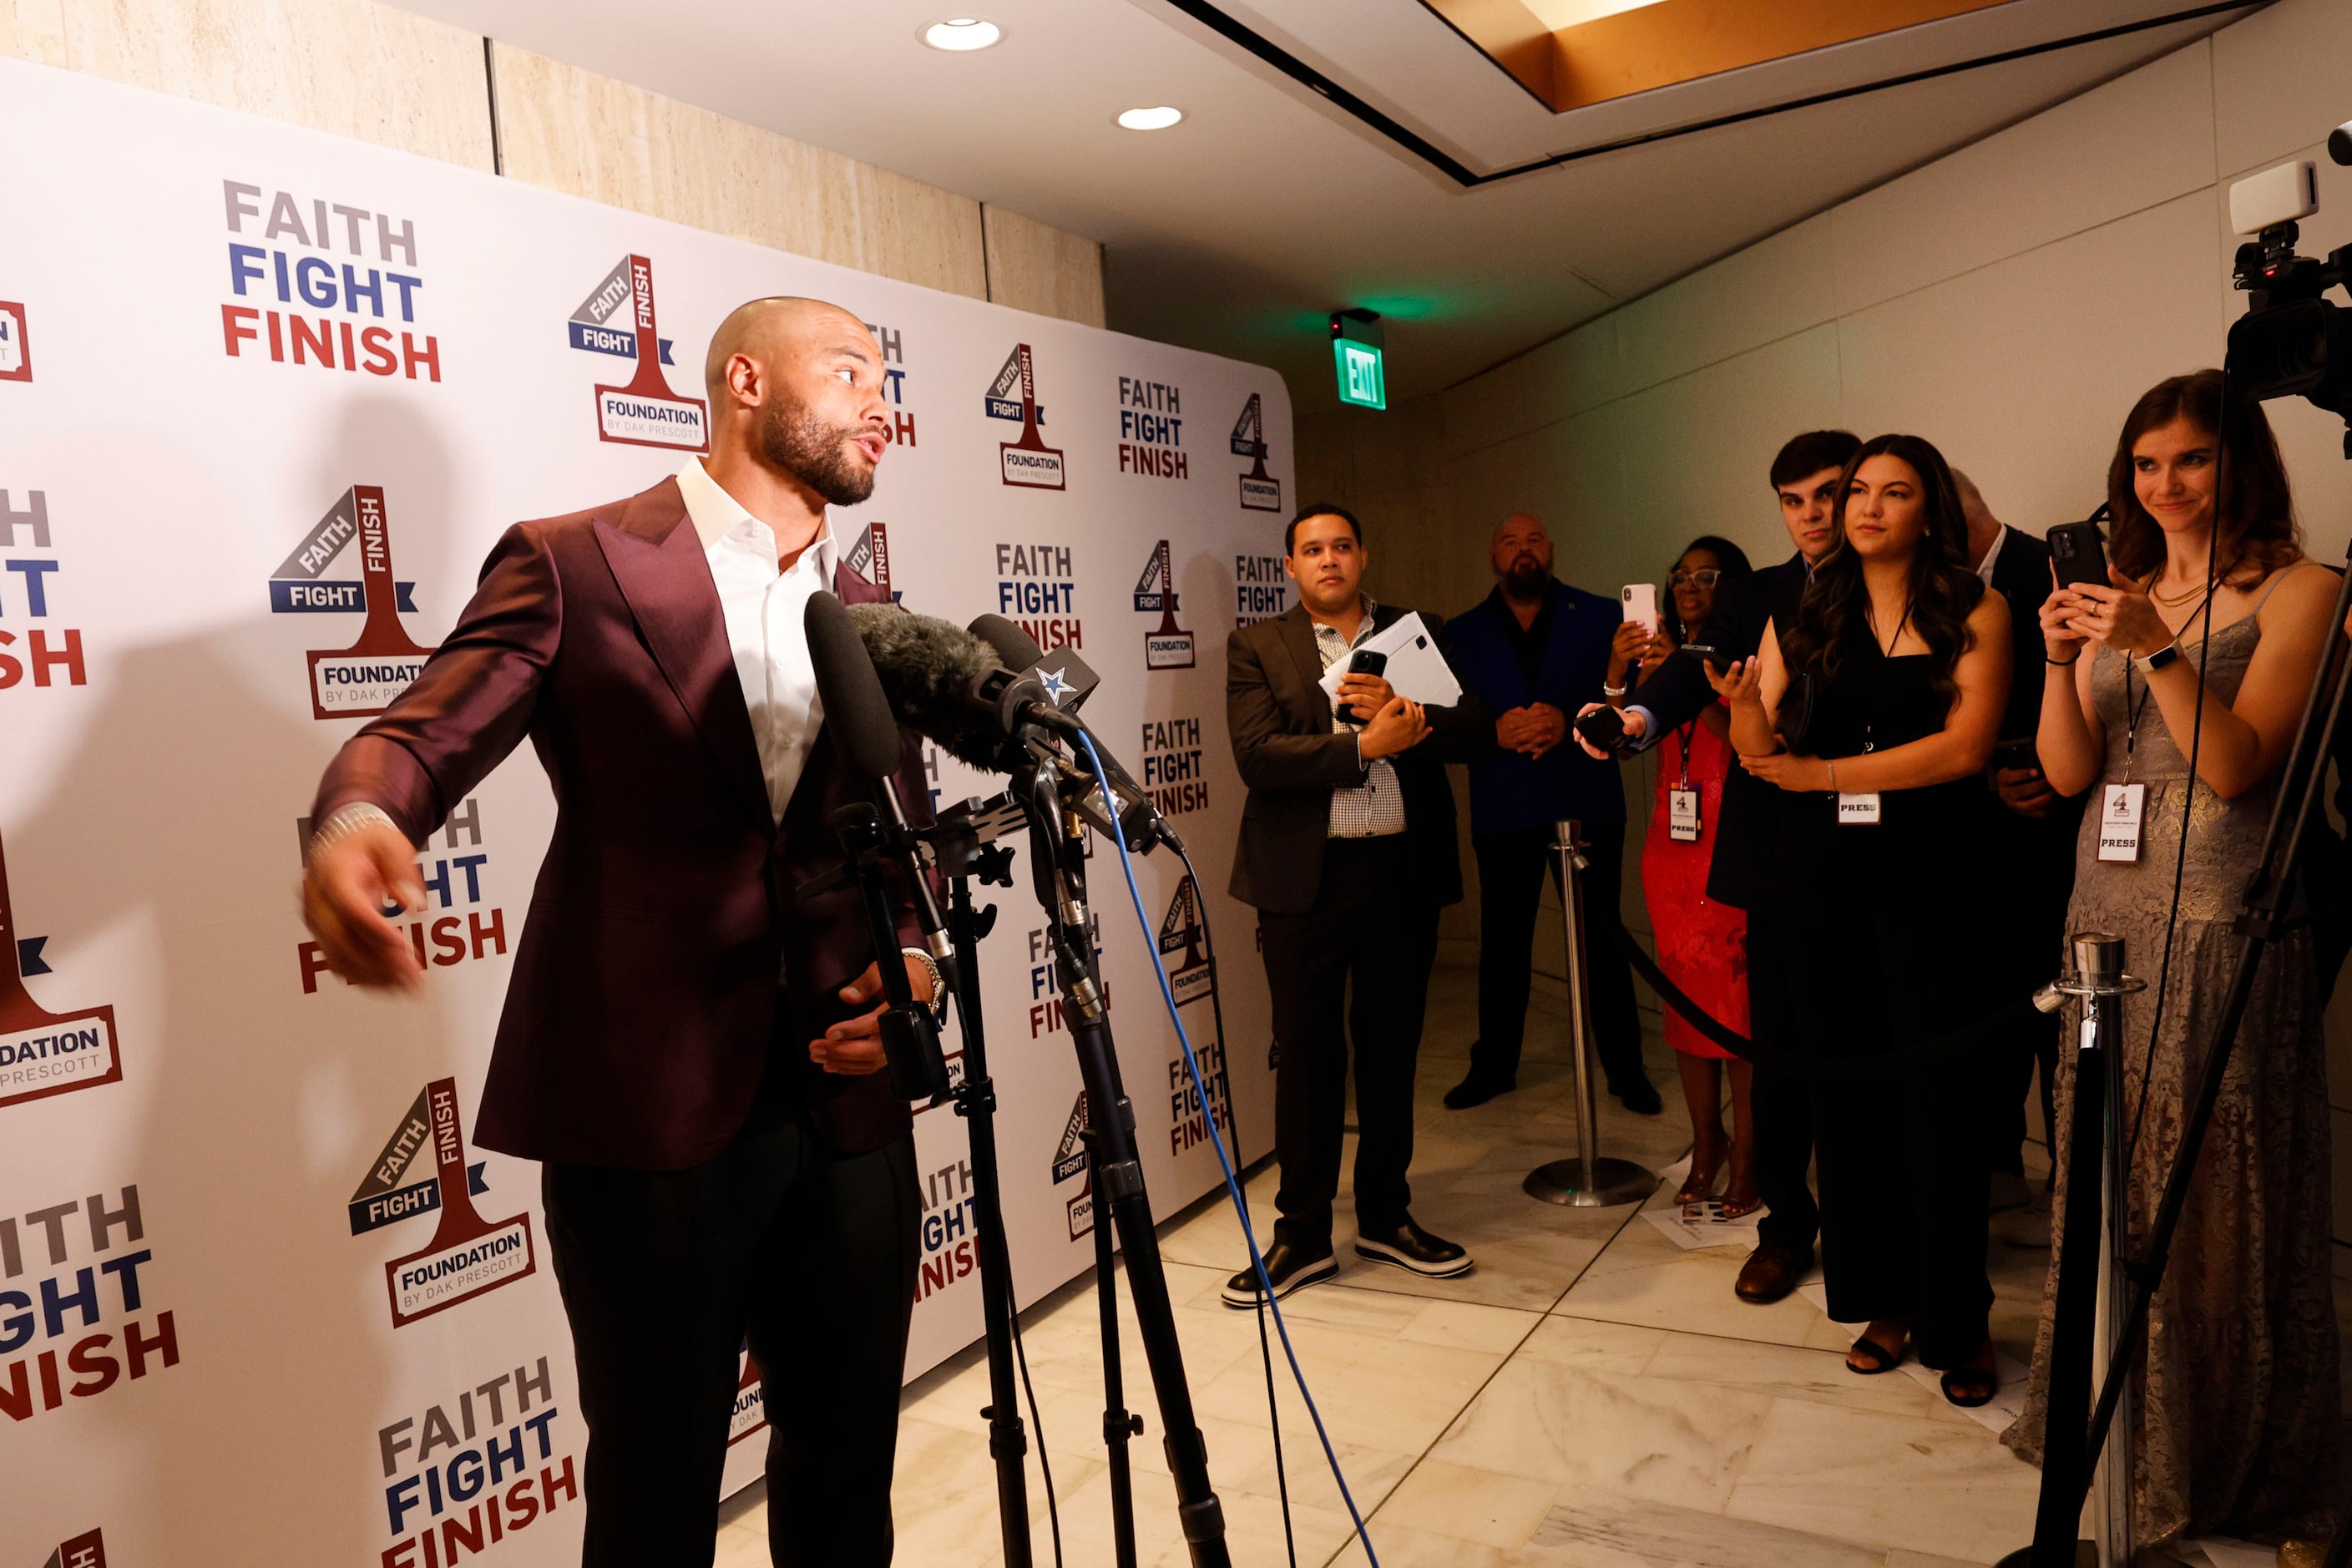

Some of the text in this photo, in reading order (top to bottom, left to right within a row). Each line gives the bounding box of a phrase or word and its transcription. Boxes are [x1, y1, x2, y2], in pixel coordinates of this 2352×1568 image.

[223, 180, 417, 266] FAITH
[229, 242, 422, 322] FIGHT
[589, 276, 629, 321] FAITH
[634, 265, 652, 329] FINISH
[221, 304, 442, 382] FINISH
[582, 328, 631, 352] FIGHT
[996, 361, 1019, 395] FAITH
[1020, 351, 1033, 398] FINISH
[1346, 347, 1378, 402] EXIT
[606, 400, 699, 426] FOUNDATION
[993, 402, 1020, 417] FIGHT
[1119, 377, 1181, 414] FAITH
[608, 419, 699, 439] BY DAK PRESCOTT
[1120, 410, 1182, 446] FIGHT
[1006, 454, 1060, 470] FOUNDATION
[1119, 443, 1188, 480] FINISH
[298, 514, 352, 574] FAITH
[361, 498, 386, 572] FINISH
[849, 544, 870, 572] ITH
[873, 531, 888, 584] FINISH
[996, 544, 1072, 577] FAITH
[1142, 557, 1160, 589] FAITH
[1161, 547, 1171, 589] FINISH
[1236, 555, 1285, 583] FAITH
[290, 586, 357, 607] FIGHT
[999, 582, 1074, 614] FIGHT
[1139, 596, 1161, 608] FIGHT
[1237, 586, 1286, 612] FIGHT
[1014, 619, 1082, 650] NISH
[1150, 640, 1191, 651] FOUNDATION
[324, 665, 422, 685] FOUNDAT
[326, 690, 343, 702] BY
[350, 689, 377, 701] DAK
[1142, 718, 1201, 752] FAITH
[1144, 750, 1202, 786] FIGHT
[2102, 838, 2136, 847] PRESS
[1166, 894, 1183, 930] FAITH
[1164, 933, 1185, 950] FIGHT
[1175, 968, 1211, 989] FOUNDATIO
[0, 1028, 99, 1066] DATION
[0, 1055, 99, 1087] PRESCOTT
[433, 1090, 458, 1165] FINISH
[1061, 1114, 1081, 1155] FAITH
[376, 1118, 427, 1186] FAITH
[1059, 1155, 1084, 1178] FIGHT
[921, 1160, 973, 1212] ITH
[368, 1186, 432, 1223] FIGHT
[0, 1184, 144, 1279] ITH
[923, 1196, 978, 1252] GHT
[402, 1232, 521, 1291] FOUNDATION
[404, 1253, 522, 1308] BY DAK PRESCOTT
[0, 1248, 152, 1354] GHT
[0, 1310, 180, 1422] NISH
[378, 1355, 552, 1478] FAITH
[386, 1407, 558, 1536] FIGHT
